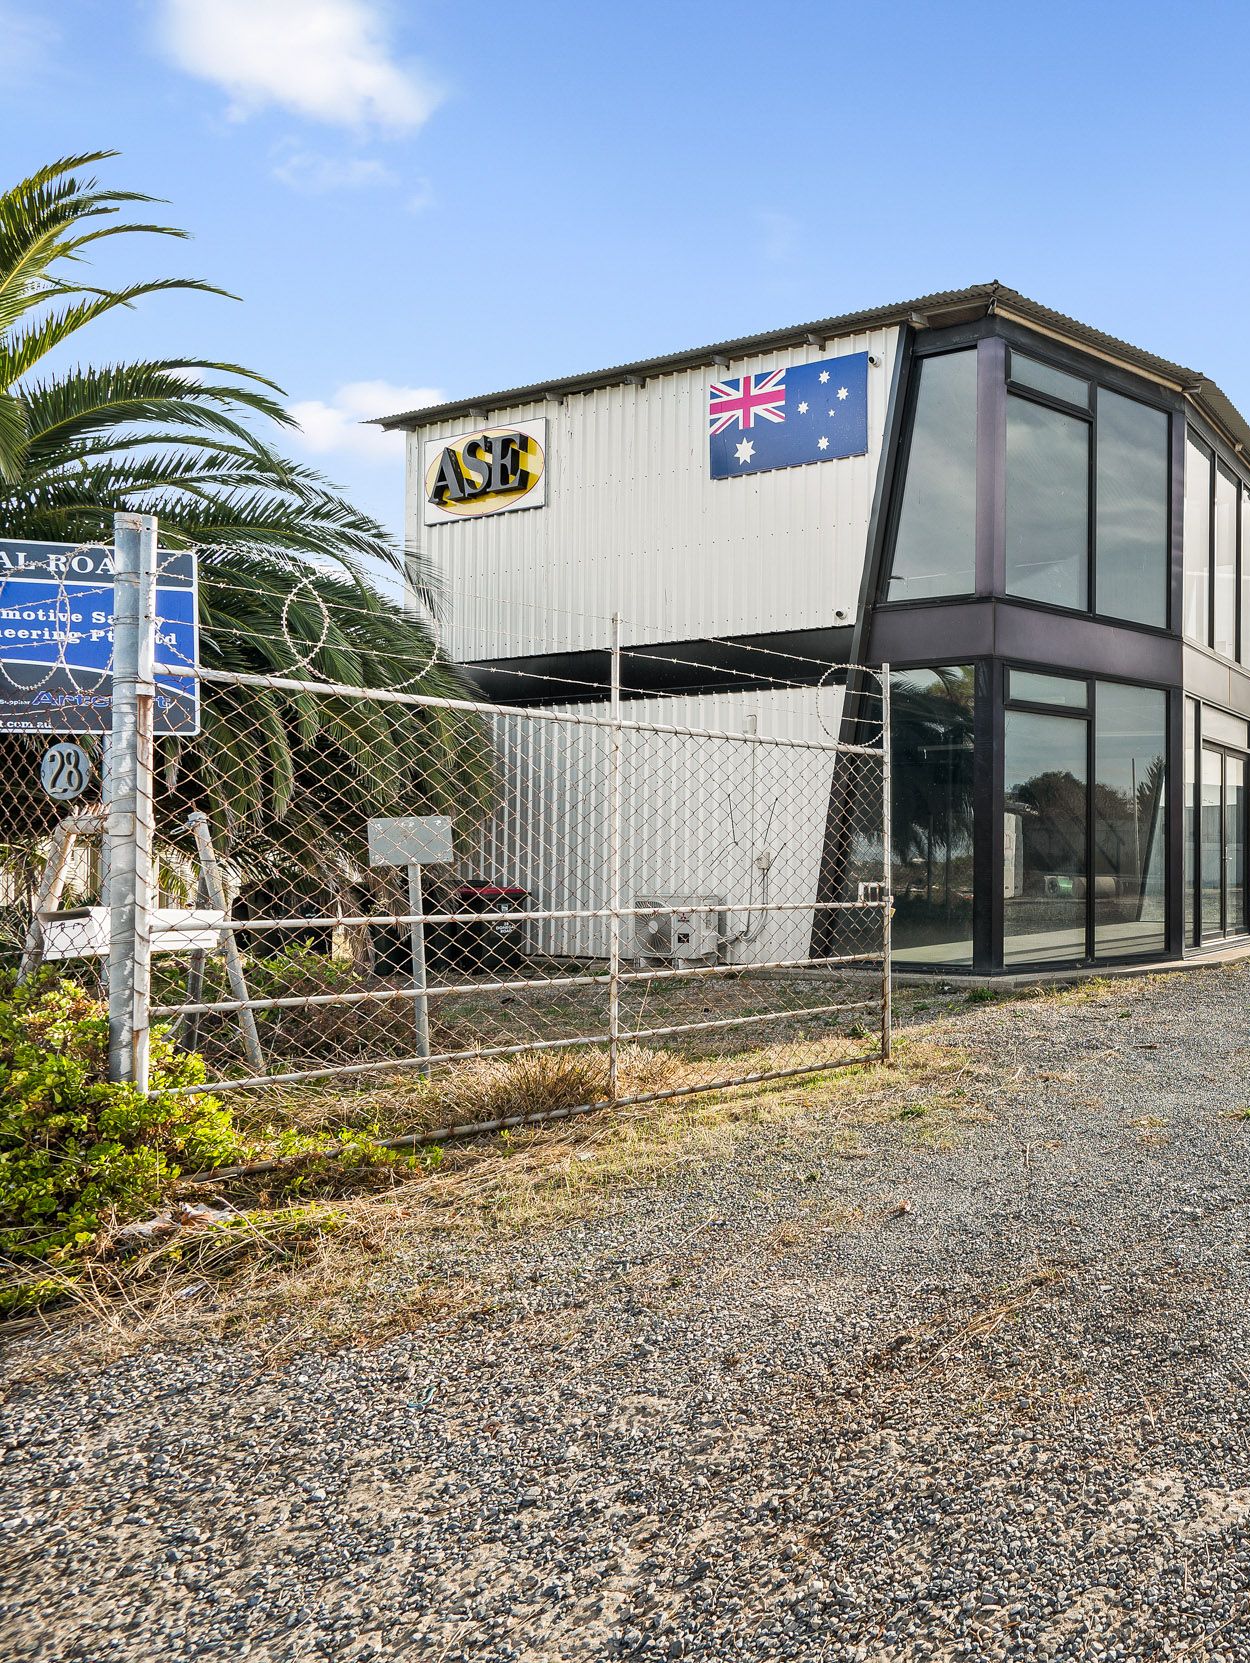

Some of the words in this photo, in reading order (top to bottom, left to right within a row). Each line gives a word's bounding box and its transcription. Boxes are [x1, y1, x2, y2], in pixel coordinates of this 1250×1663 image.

[428, 433, 528, 505] ASE
[47, 554, 115, 575] ROA
[48, 749, 83, 794] 28
